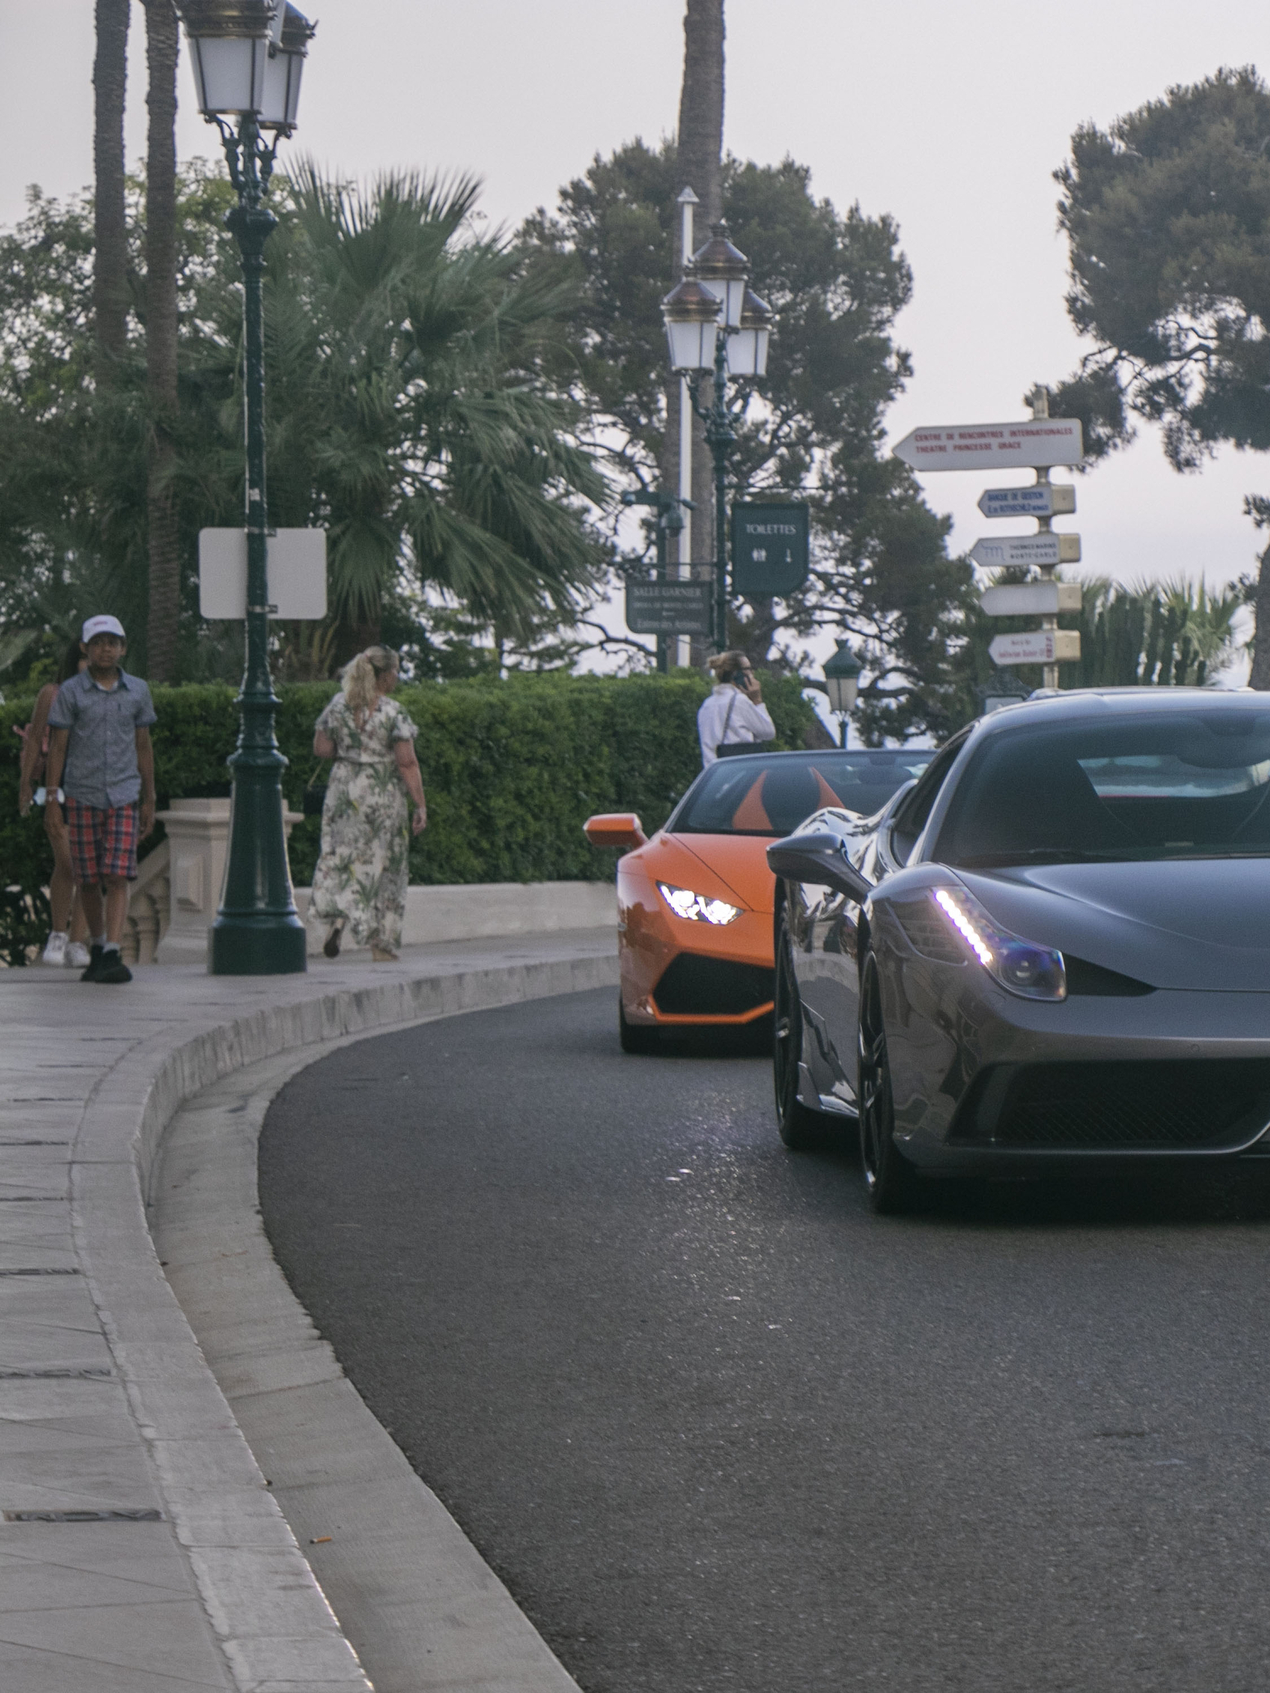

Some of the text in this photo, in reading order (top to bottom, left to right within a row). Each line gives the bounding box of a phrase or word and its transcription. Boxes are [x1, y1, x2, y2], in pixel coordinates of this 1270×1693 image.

[915, 427, 1073, 442] CENTRE DE RENCONTRES INTERNATIONALES
[953, 443, 992, 452] PRINCESSE
[998, 441, 1022, 450] GRACE
[745, 524, 797, 535] TOILETTES
[633, 587, 702, 597] SALLE GARNIER
